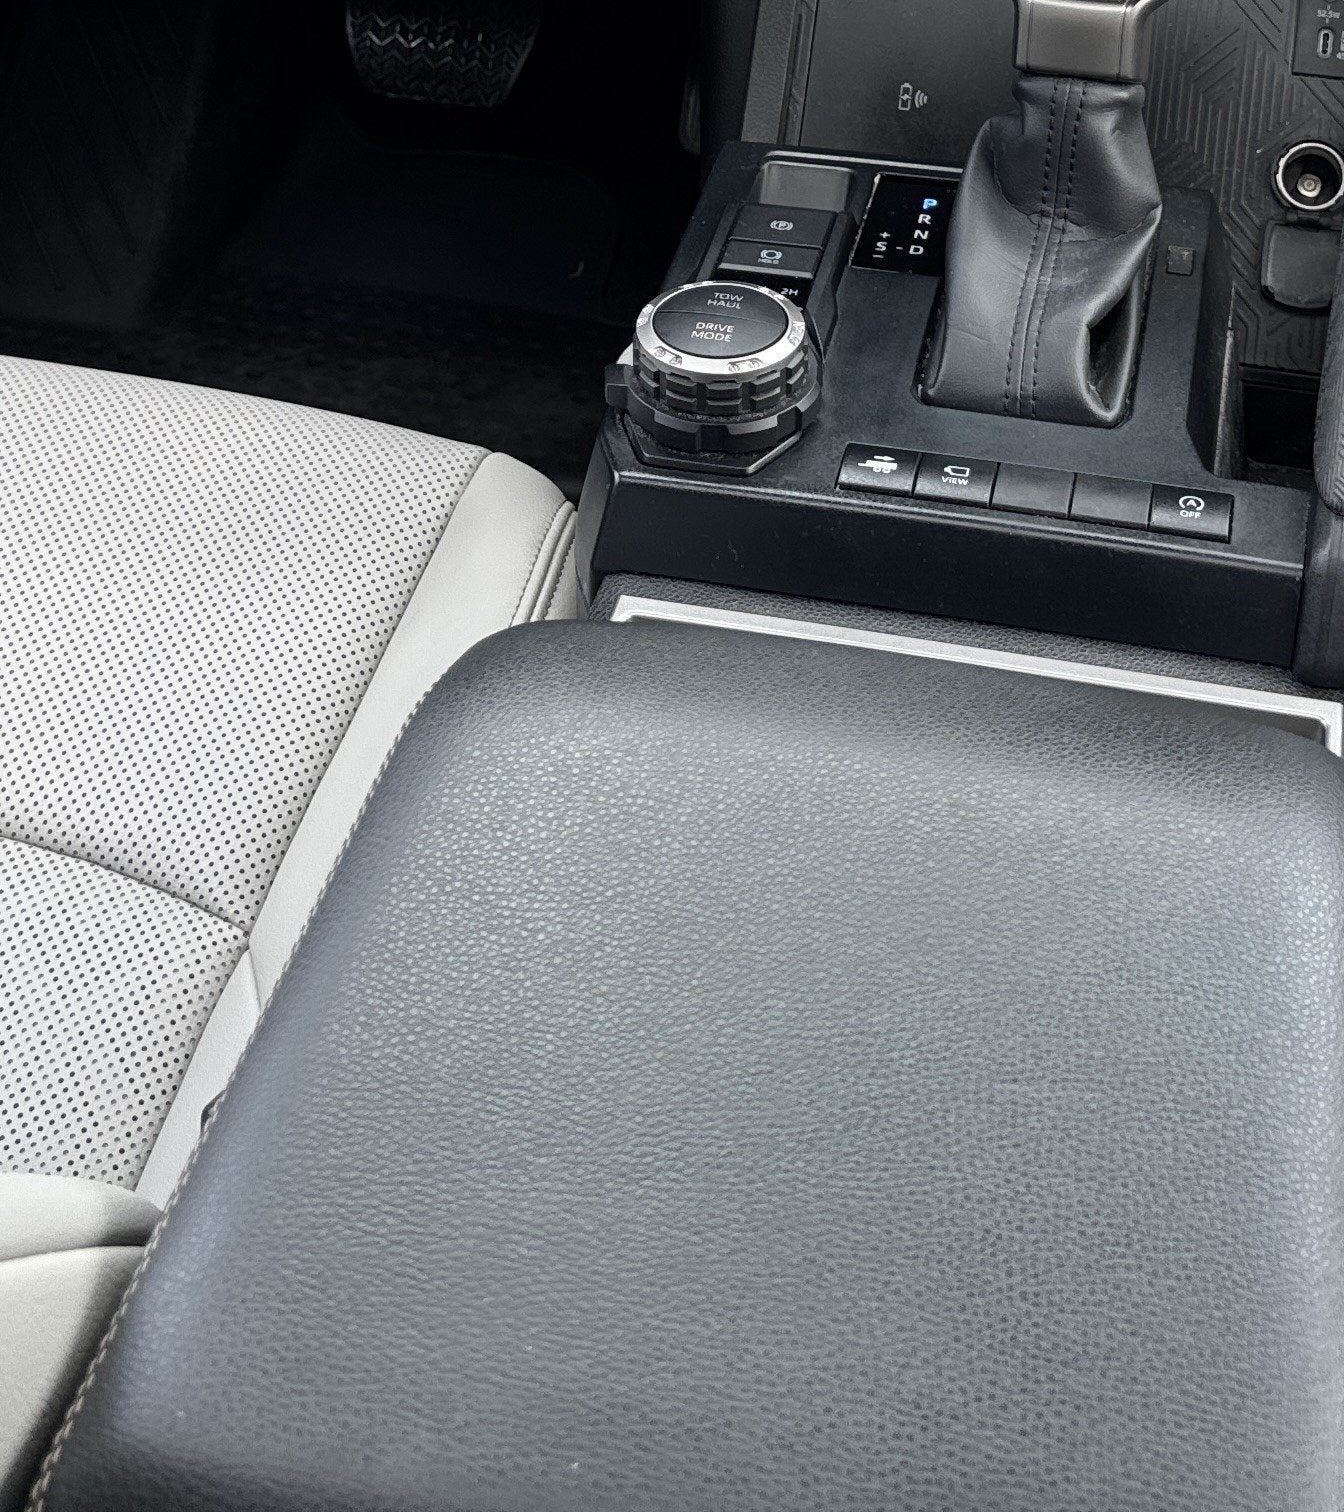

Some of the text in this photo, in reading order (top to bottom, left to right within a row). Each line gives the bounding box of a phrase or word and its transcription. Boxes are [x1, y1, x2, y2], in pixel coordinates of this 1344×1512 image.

[922, 198, 938, 210] P
[917, 213, 932, 225] R
[913, 229, 929, 240] N
[874, 241, 887, 252] S
[908, 244, 924, 255] D
[757, 257, 780, 265] HOLD
[713, 292, 744, 302] TOW
[780, 287, 799, 296] 2H
[707, 299, 742, 310] HAUL
[695, 321, 735, 333] DRIVE
[690, 330, 733, 343] MODE
[941, 475, 970, 486] VIEW
[1179, 509, 1202, 519] OFF
